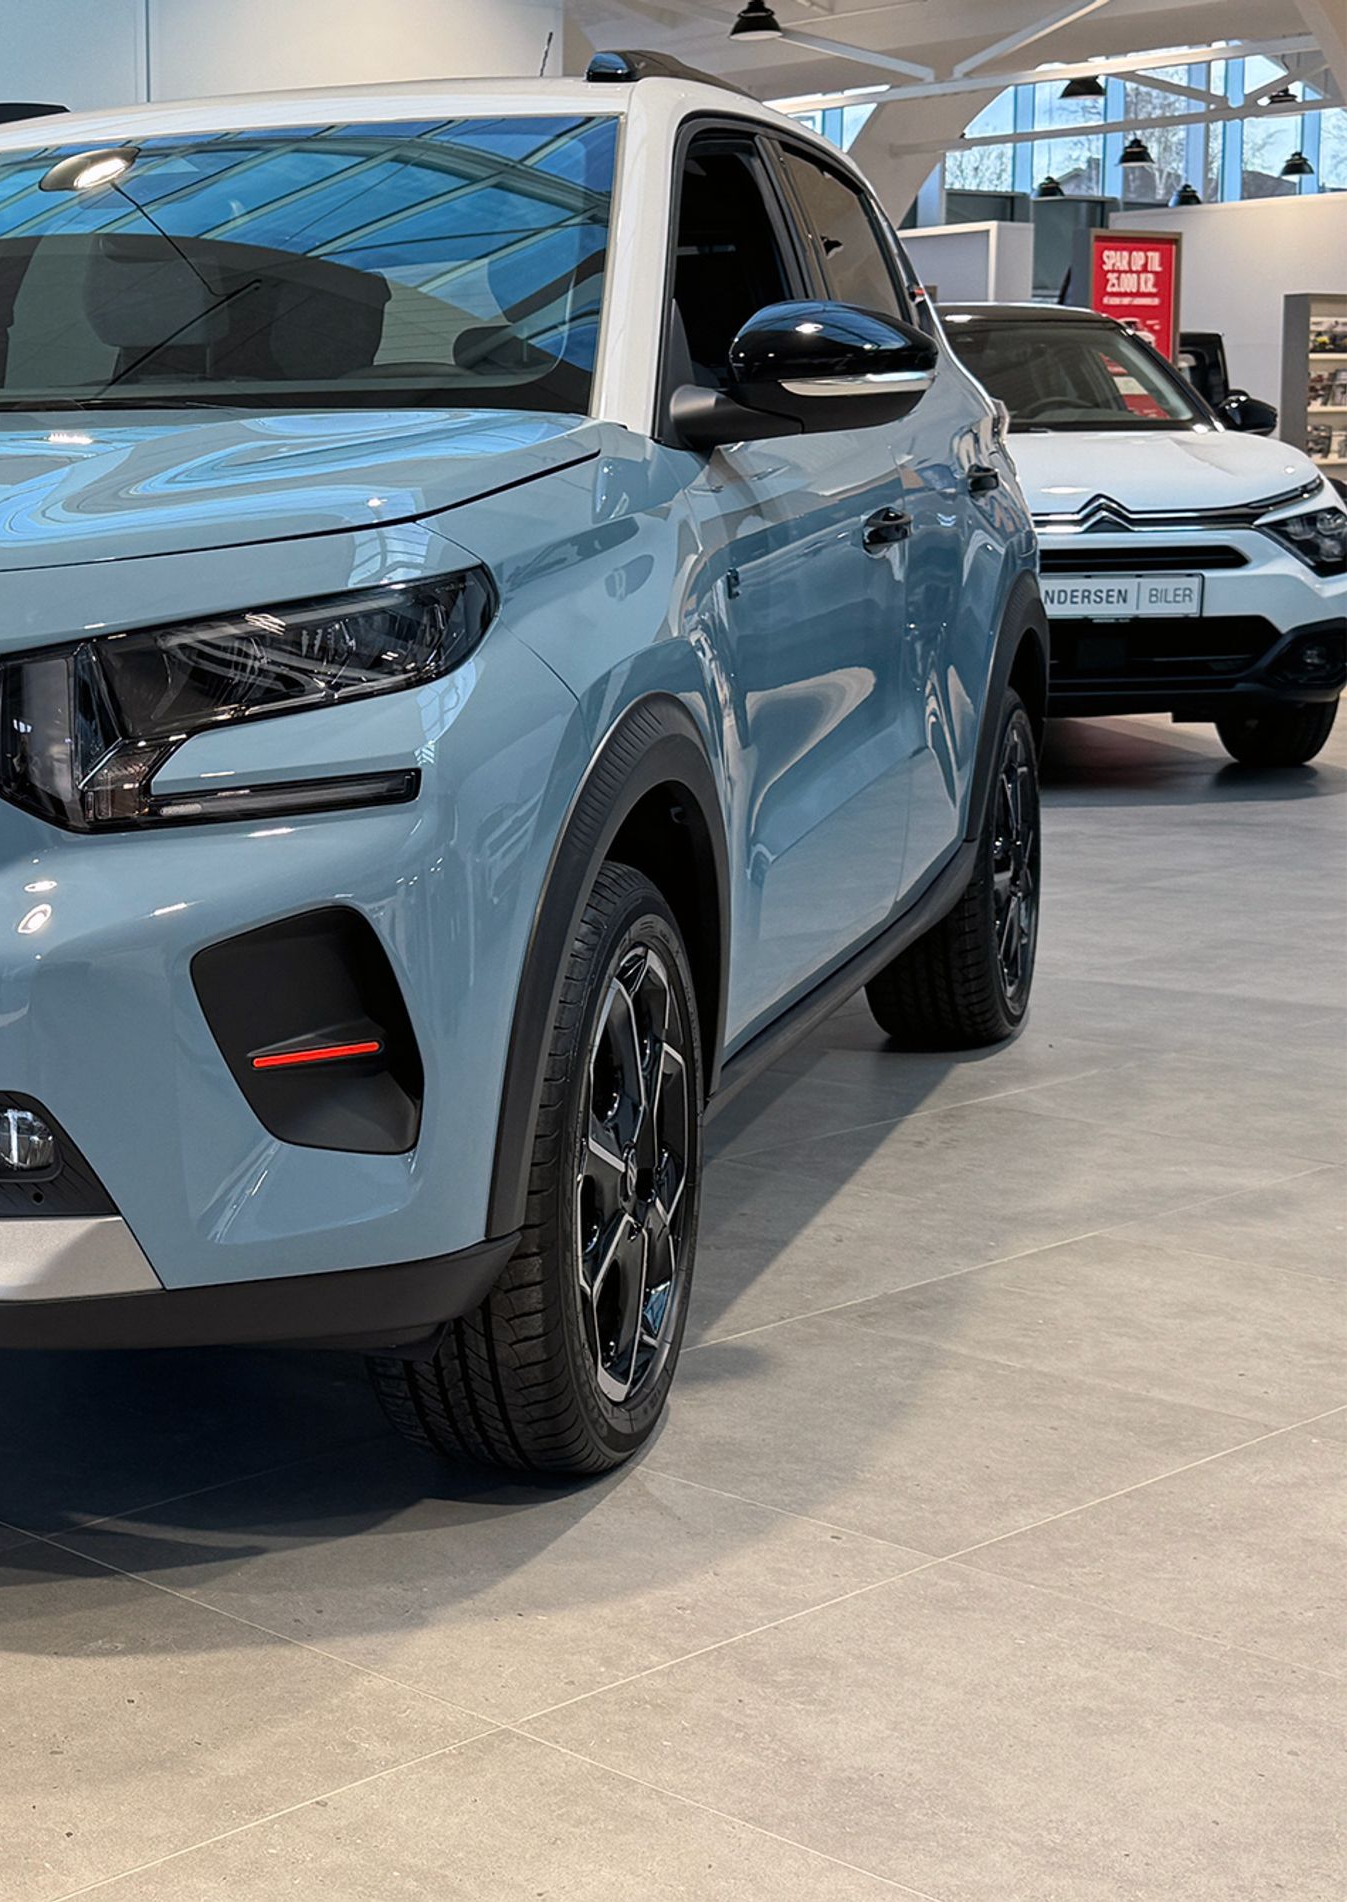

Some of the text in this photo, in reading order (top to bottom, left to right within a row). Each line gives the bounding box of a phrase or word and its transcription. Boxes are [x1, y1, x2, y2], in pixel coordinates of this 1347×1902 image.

[1102, 250, 1163, 272] SPAR OP TIL
[1148, 587, 1194, 604] BILER
